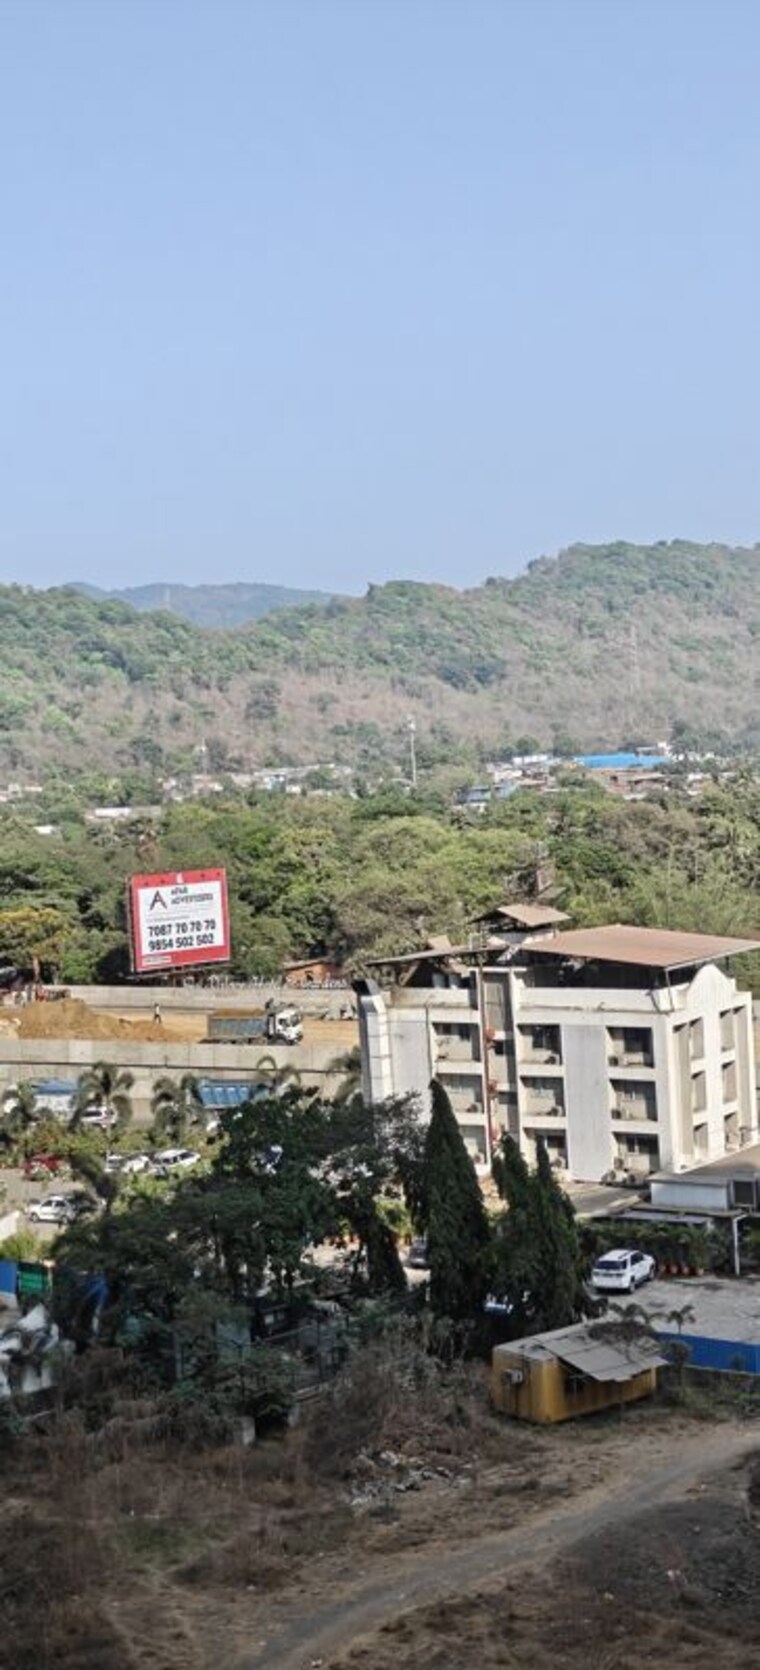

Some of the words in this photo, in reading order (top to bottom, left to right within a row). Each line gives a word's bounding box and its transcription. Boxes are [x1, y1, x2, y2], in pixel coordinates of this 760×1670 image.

[148, 923, 172, 937] 7087
[175, 922, 188, 934] 70
[190, 920, 202, 932] 70
[204, 918, 216, 930] 70
[148, 938, 173, 952] 9854
[175, 935, 194, 949] 502
[196, 932, 214, 946] 502
